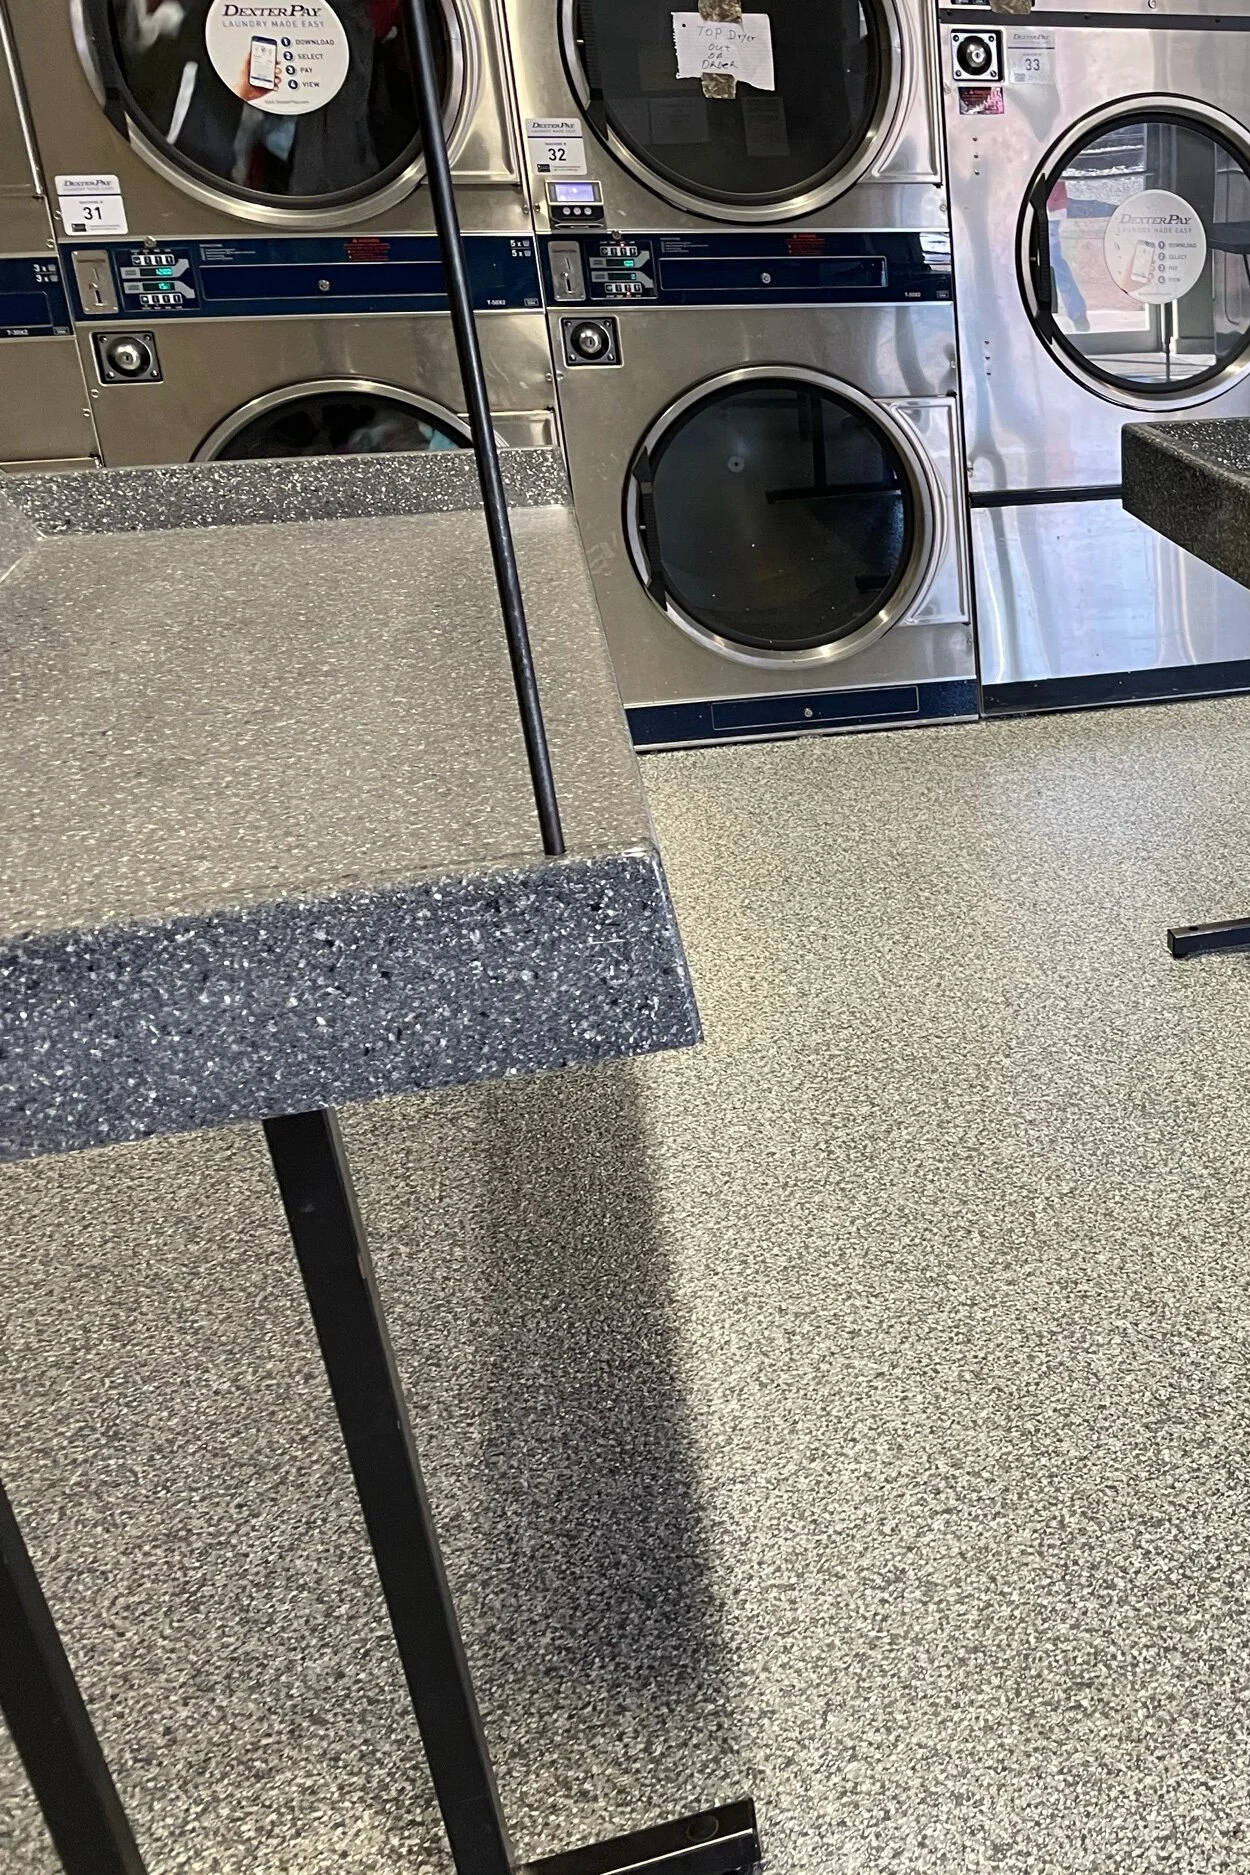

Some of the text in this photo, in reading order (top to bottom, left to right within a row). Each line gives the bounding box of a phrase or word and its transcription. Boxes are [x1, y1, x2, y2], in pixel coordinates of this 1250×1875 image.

[222, 20, 325, 28] LAUNDRY MADE EASY
[697, 26, 722, 38] TOP
[1025, 58, 1041, 71] 33
[300, 67, 313, 75] PAY
[547, 148, 567, 161] 32
[83, 206, 102, 220] 31
